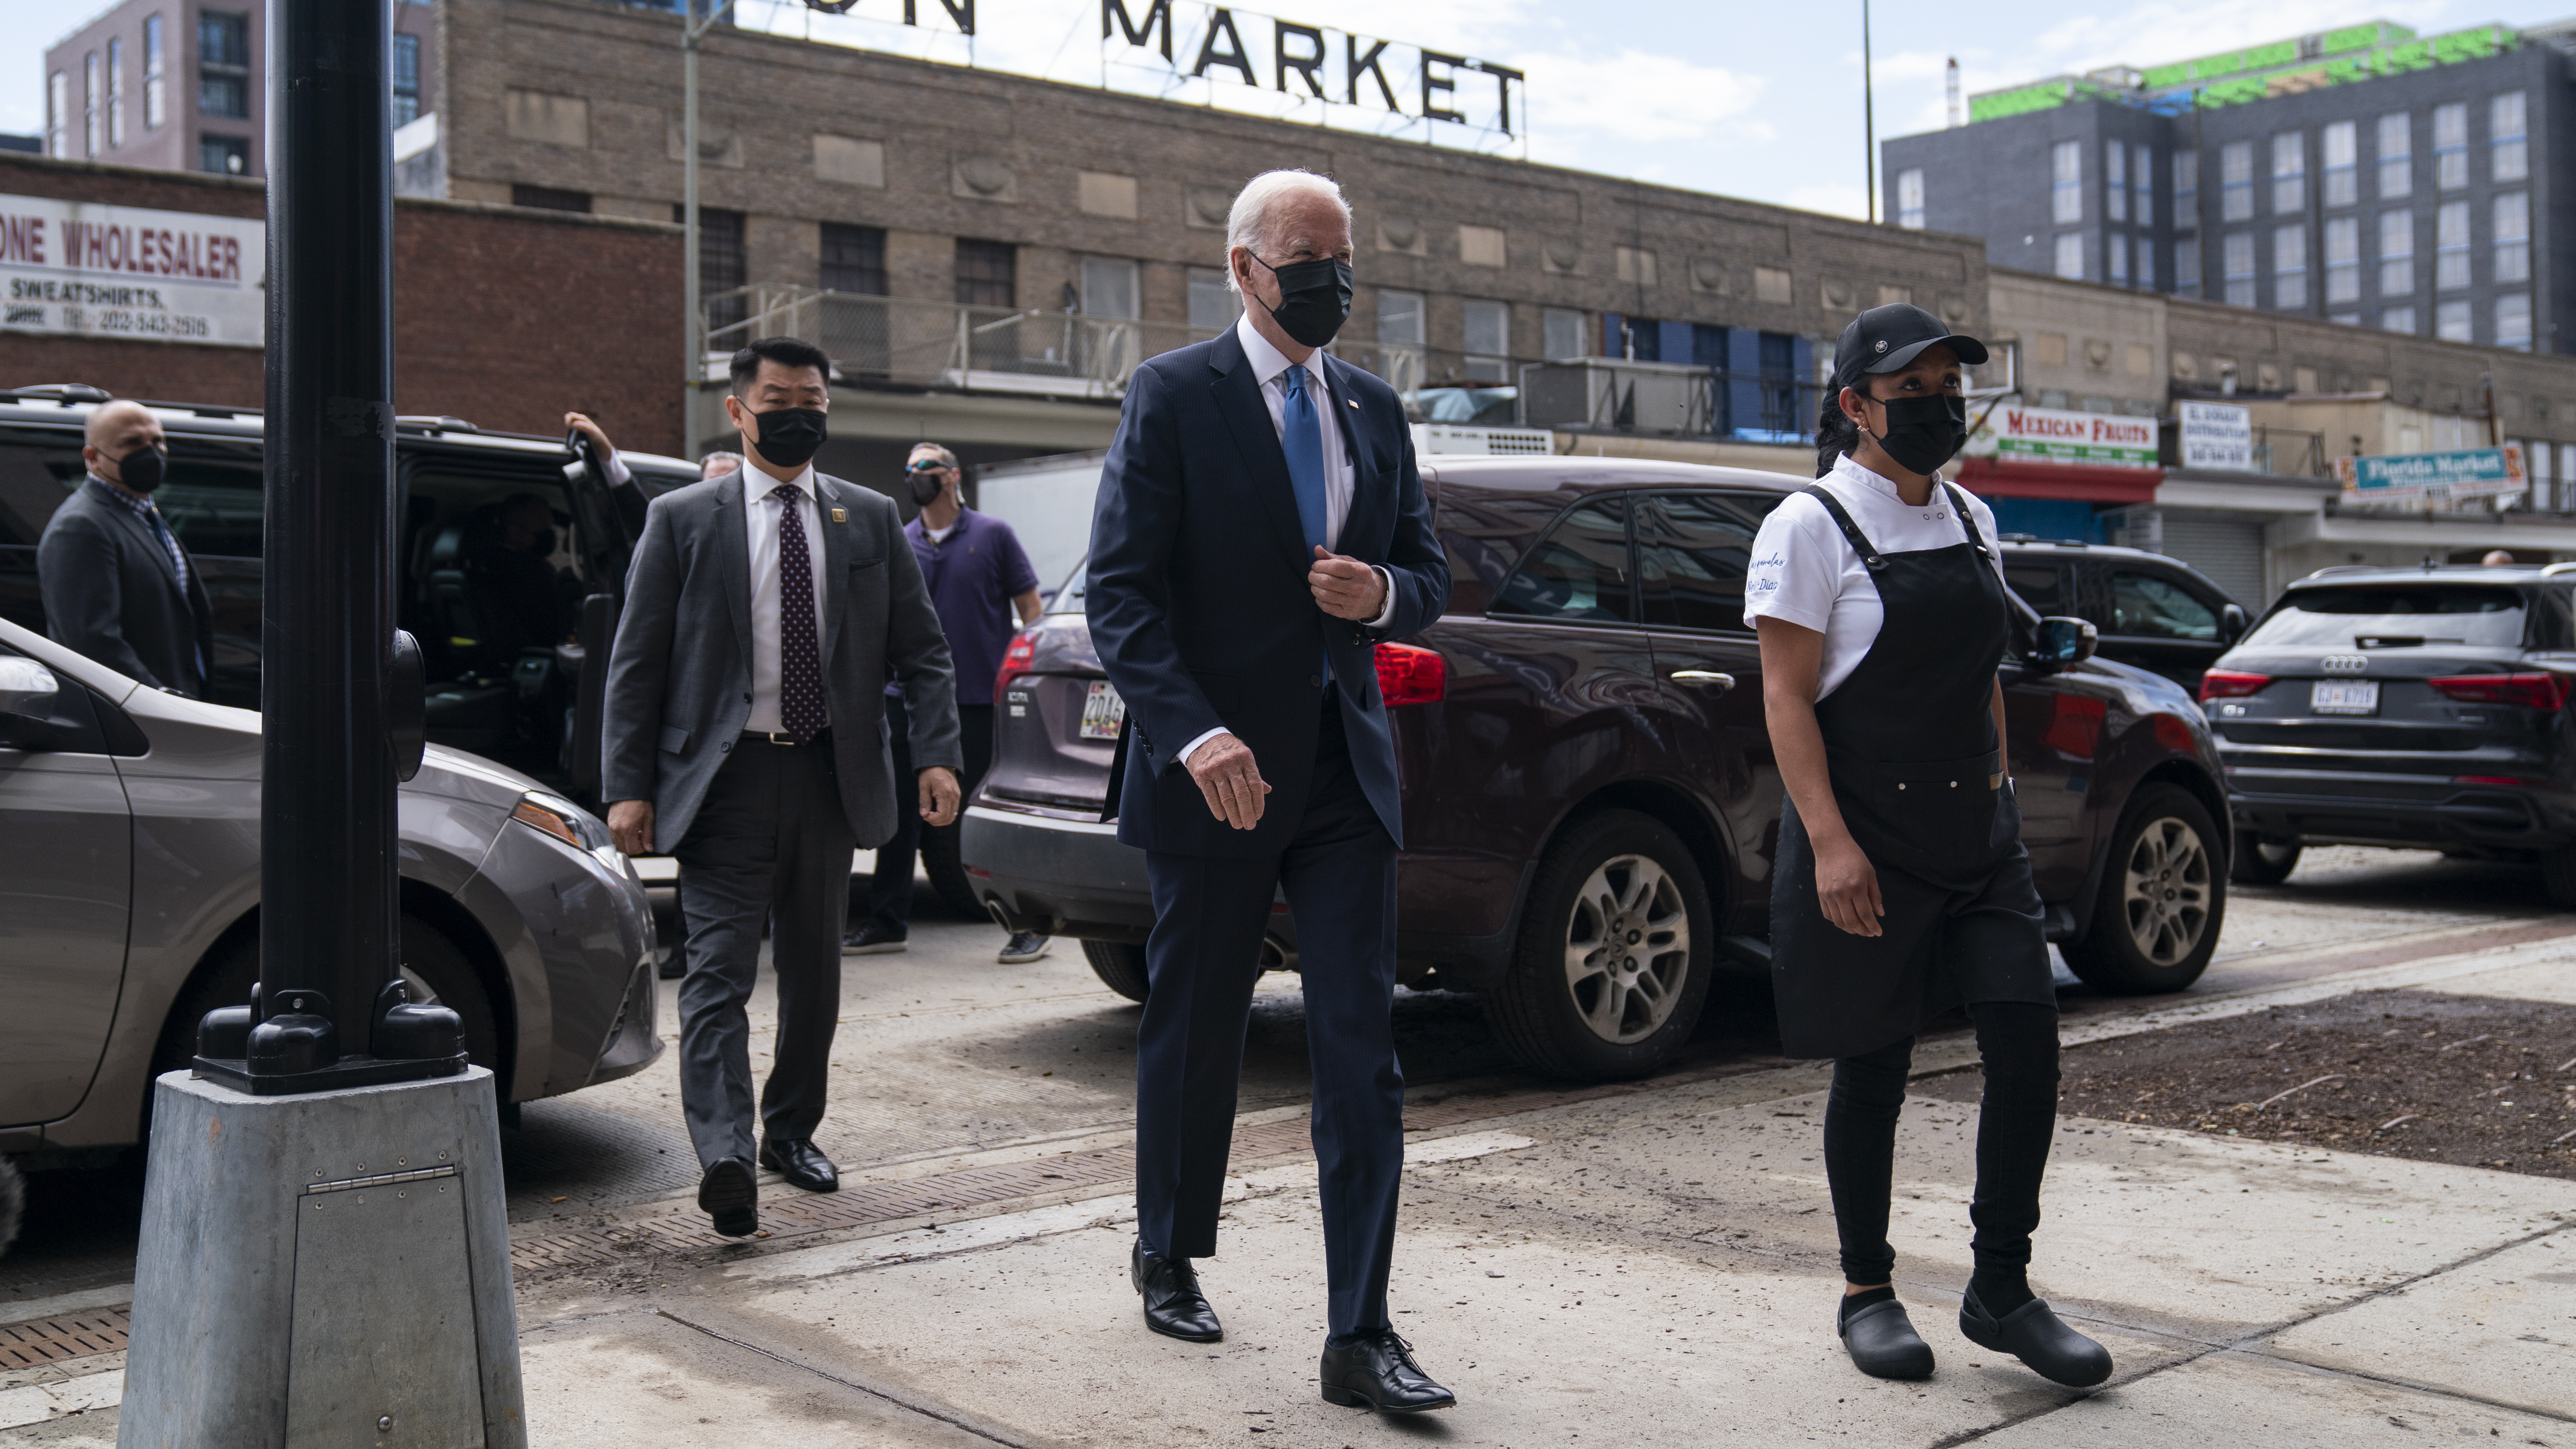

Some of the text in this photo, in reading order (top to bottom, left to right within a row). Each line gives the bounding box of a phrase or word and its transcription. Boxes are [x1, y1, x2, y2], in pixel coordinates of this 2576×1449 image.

[1102, 0, 1525, 136] MARKET
[61, 220, 241, 281] WHOLESALER
[2008, 409, 2150, 442] MEXICAN FRUITS
[2438, 453, 2499, 473] Market
